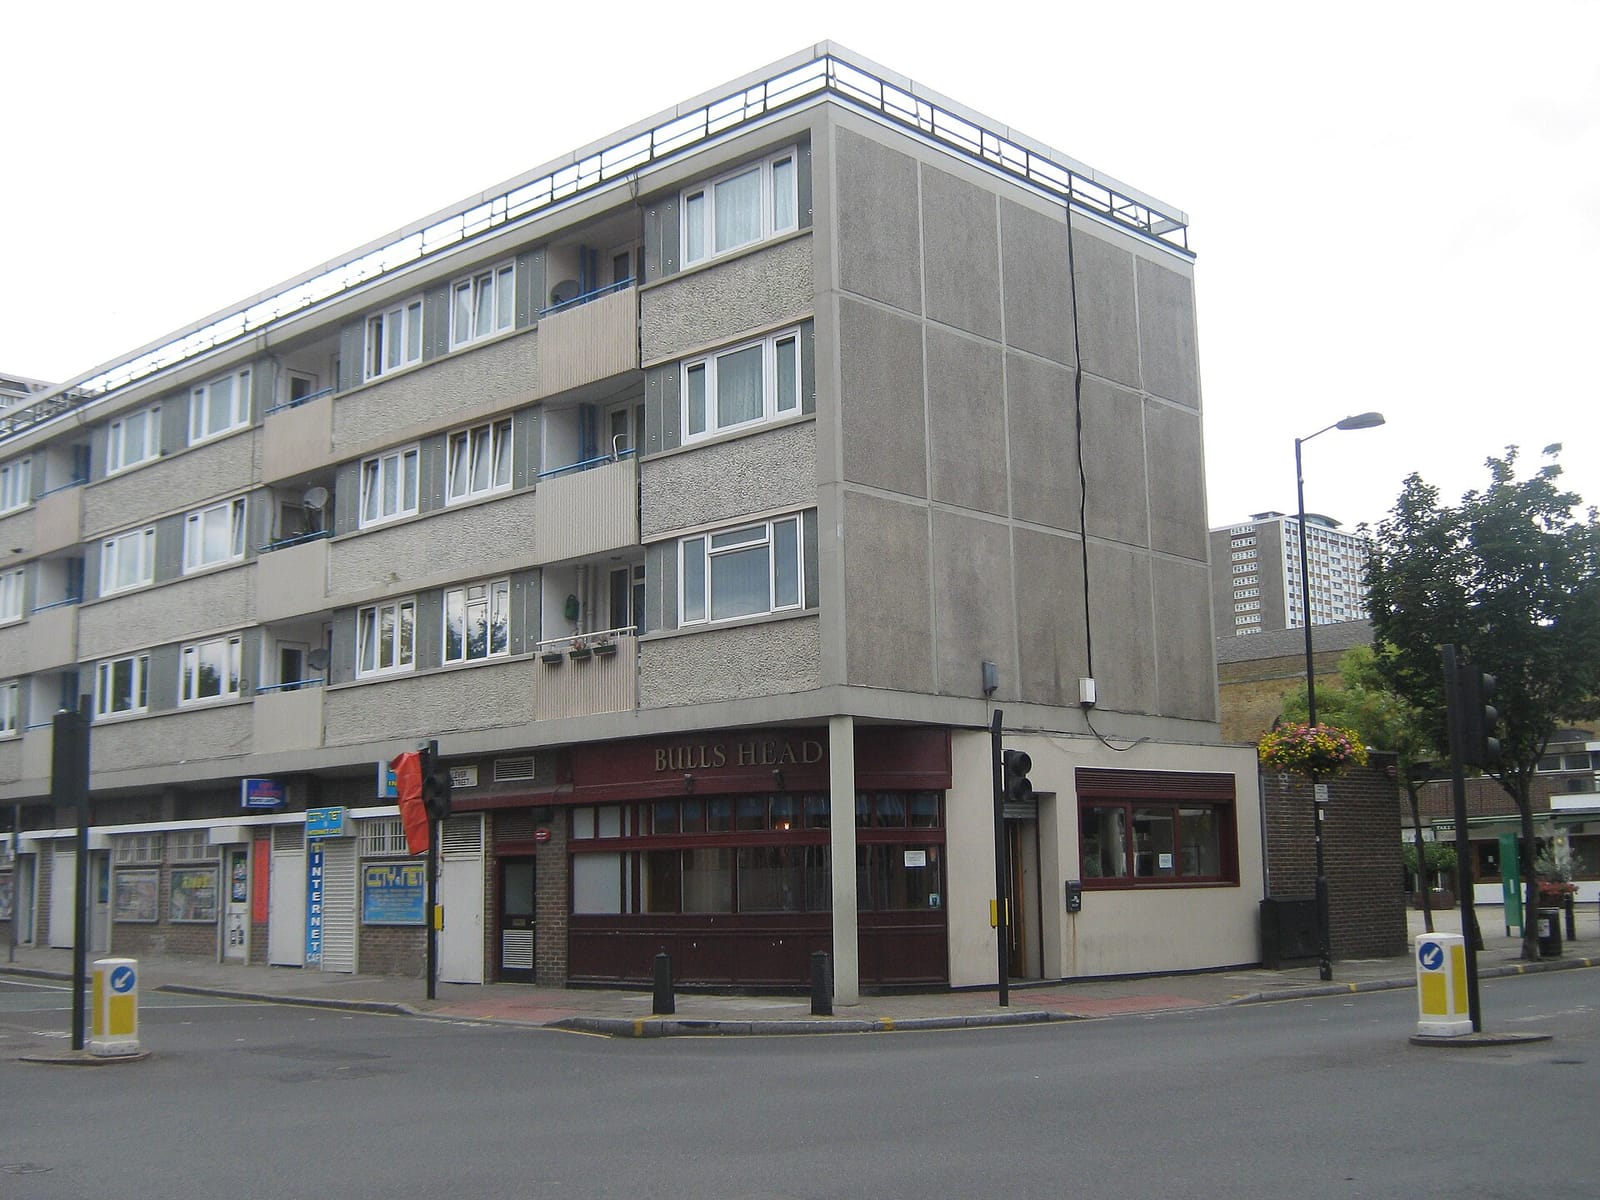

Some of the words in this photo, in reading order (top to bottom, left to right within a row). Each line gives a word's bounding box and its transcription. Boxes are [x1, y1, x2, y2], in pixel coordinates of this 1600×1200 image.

[655, 744, 726, 772] BULLS
[737, 740, 823, 766] HEAD
[310, 854, 321, 951] INTERNET
